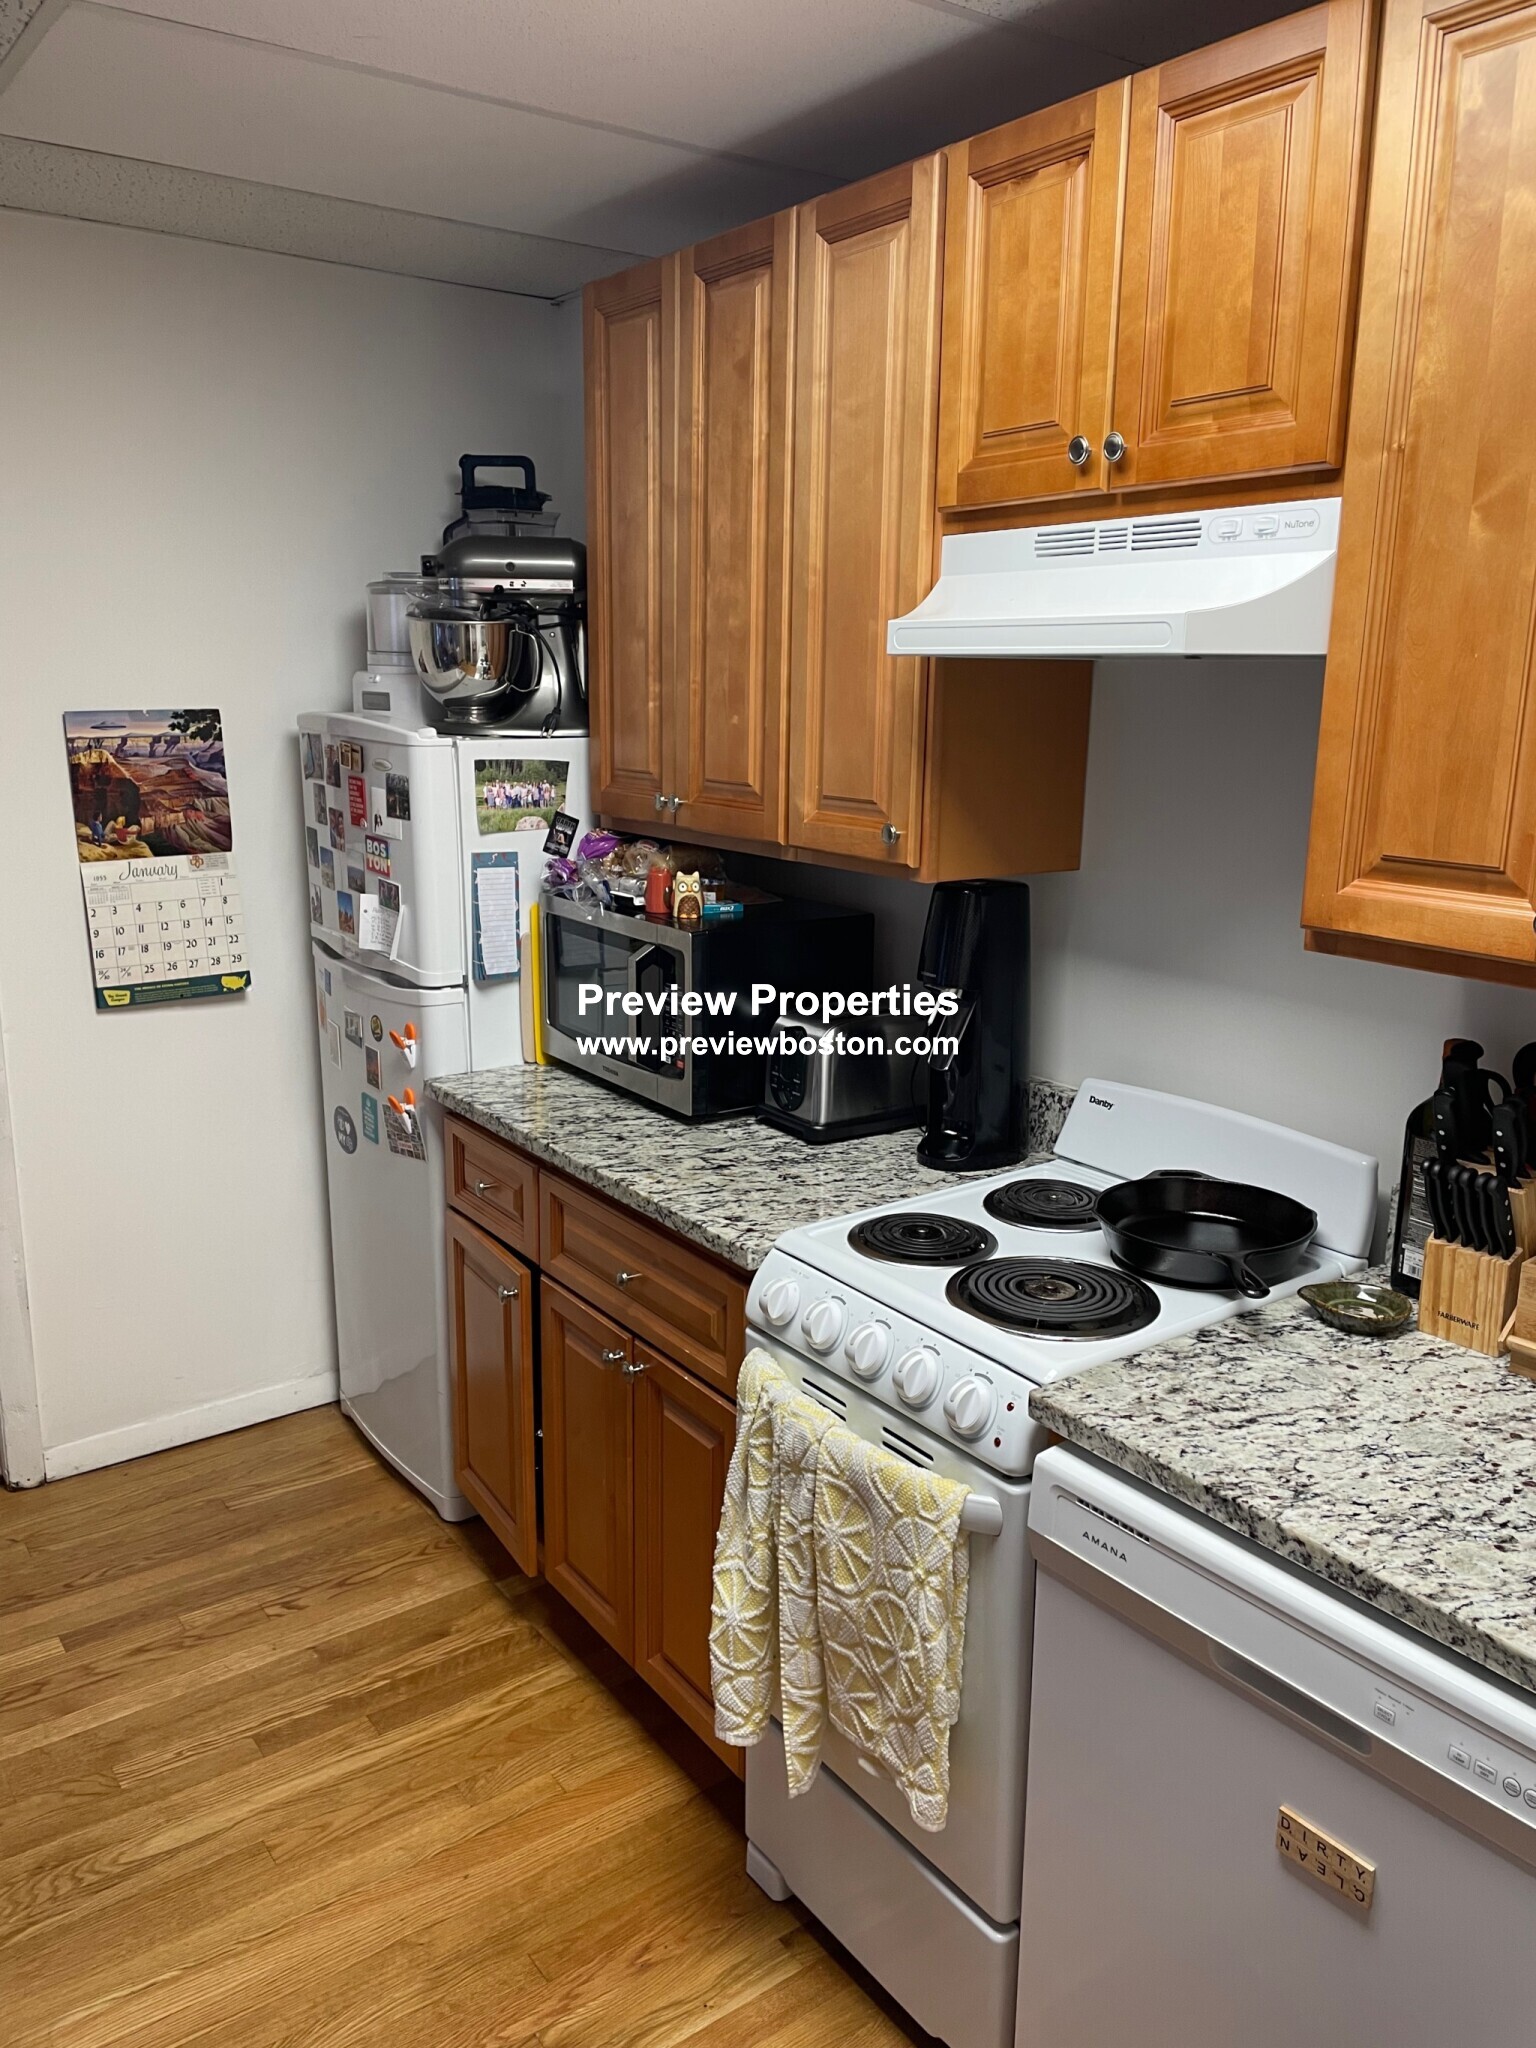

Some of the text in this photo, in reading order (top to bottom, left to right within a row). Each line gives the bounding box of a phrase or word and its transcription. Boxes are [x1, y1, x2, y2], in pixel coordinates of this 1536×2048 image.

[1284, 519, 1315, 529] NuTone
[366, 838, 387, 857] BOS
[119, 862, 178, 880] January
[367, 856, 388, 874] TON
[1089, 1095, 1114, 1110] Danby
[1437, 1310, 1480, 1331] FARBERWARE
[1082, 1531, 1128, 1562] AMANA
[1281, 1816, 1366, 1883] DIRTY
[1280, 1836, 1366, 1903] CLEAN
